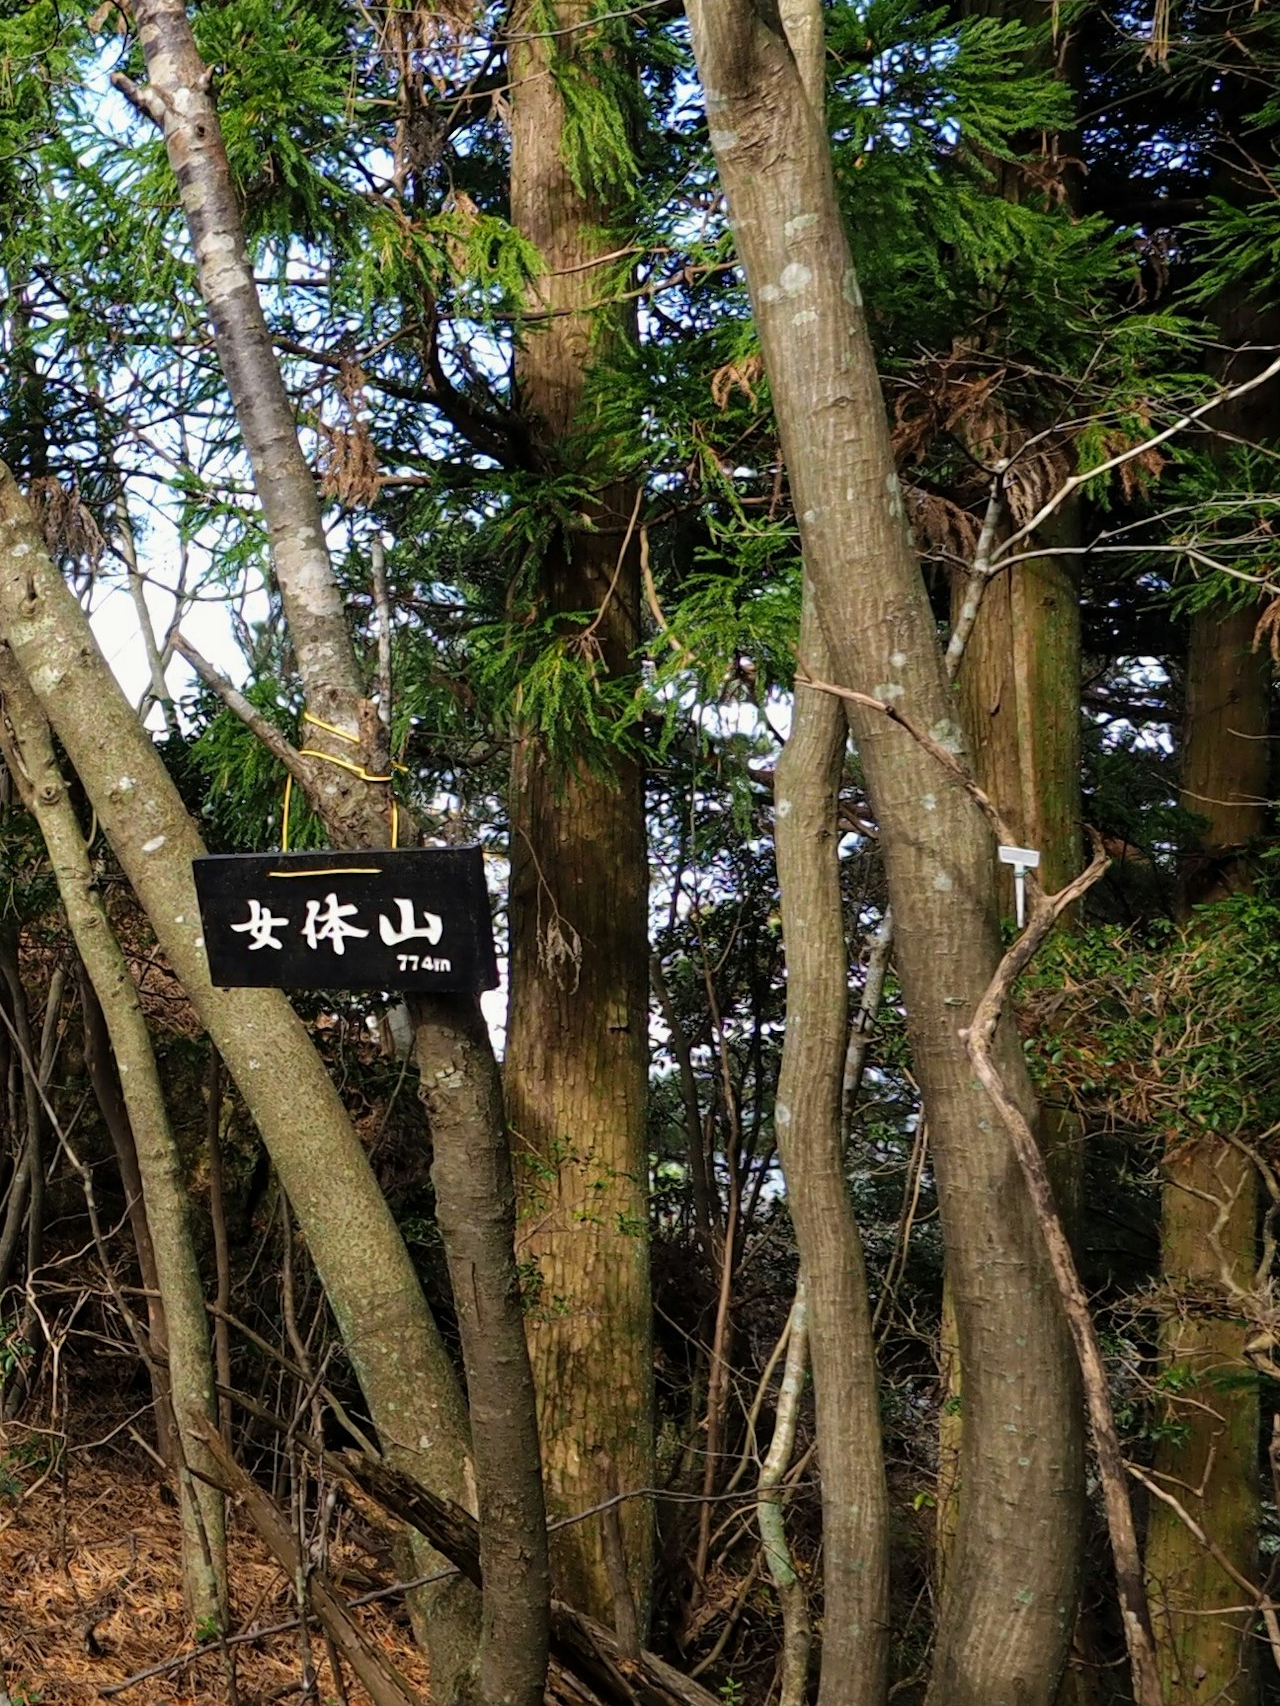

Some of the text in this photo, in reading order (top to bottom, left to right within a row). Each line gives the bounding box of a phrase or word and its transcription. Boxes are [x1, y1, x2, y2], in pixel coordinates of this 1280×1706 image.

[230, 892, 444, 956] 女体山
[396, 953, 452, 973] 774m
